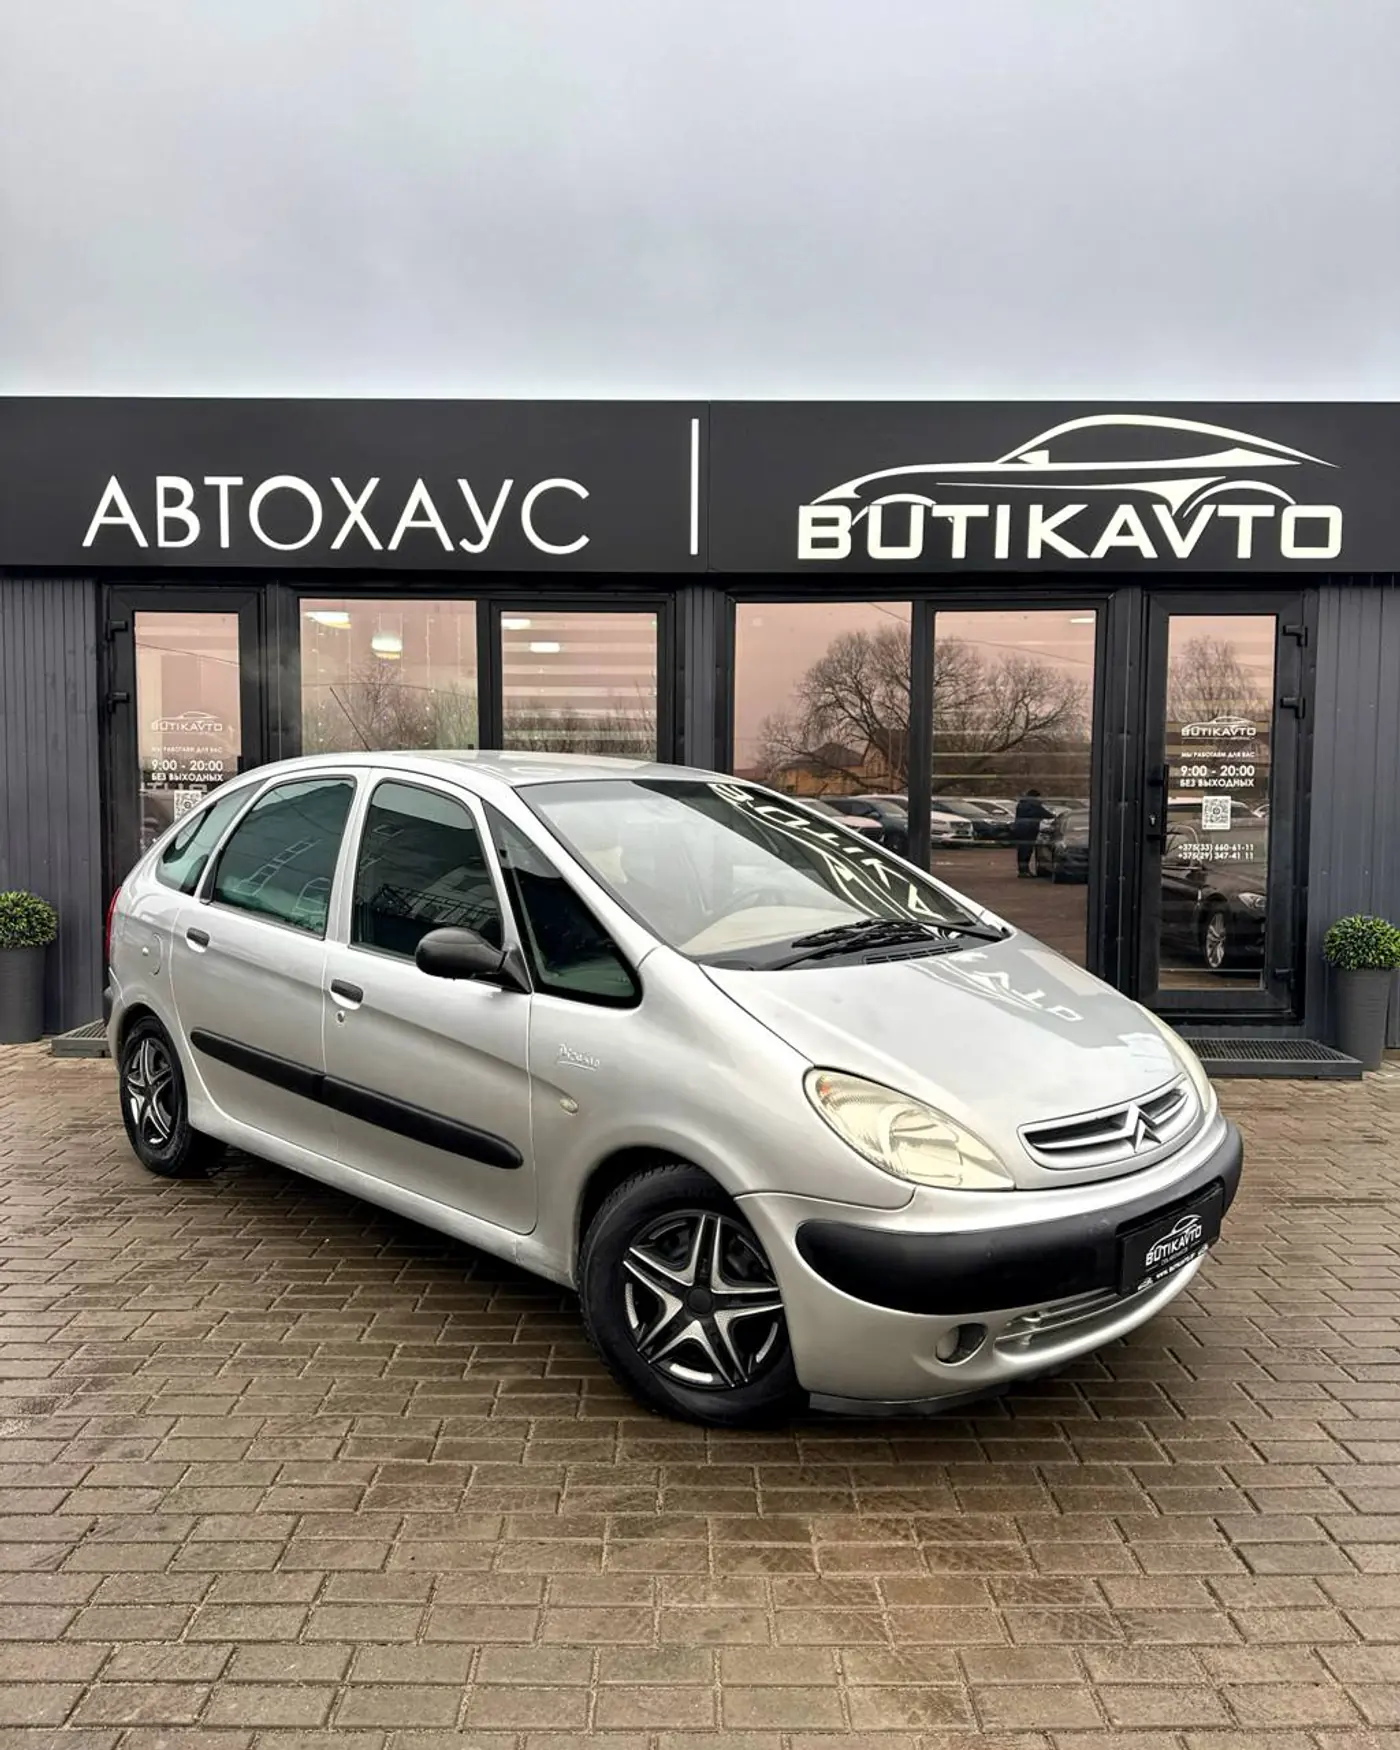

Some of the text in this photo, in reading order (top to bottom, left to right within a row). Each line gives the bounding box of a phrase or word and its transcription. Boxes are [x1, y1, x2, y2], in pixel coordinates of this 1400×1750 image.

[83, 475, 590, 554] АВТОХАУС
[797, 503, 1342, 560] BUTIKAVTO
[1181, 727, 1257, 736] BUTIKAVTO
[152, 759, 178, 771] 9:00
[189, 760, 224, 771] 20:00
[1180, 765, 1207, 777] 9:00
[1219, 765, 1255, 777] 20:00
[151, 772, 224, 782] БЕЗ ВЫХОДНЫХ
[1179, 778, 1255, 788] БЕЗ ВЫХОДНЫХ
[1214, 843, 1254, 852] 660-61-11
[1214, 852, 1254, 860] 347-4111
[1146, 1224, 1202, 1266] BUTIKAVTO
